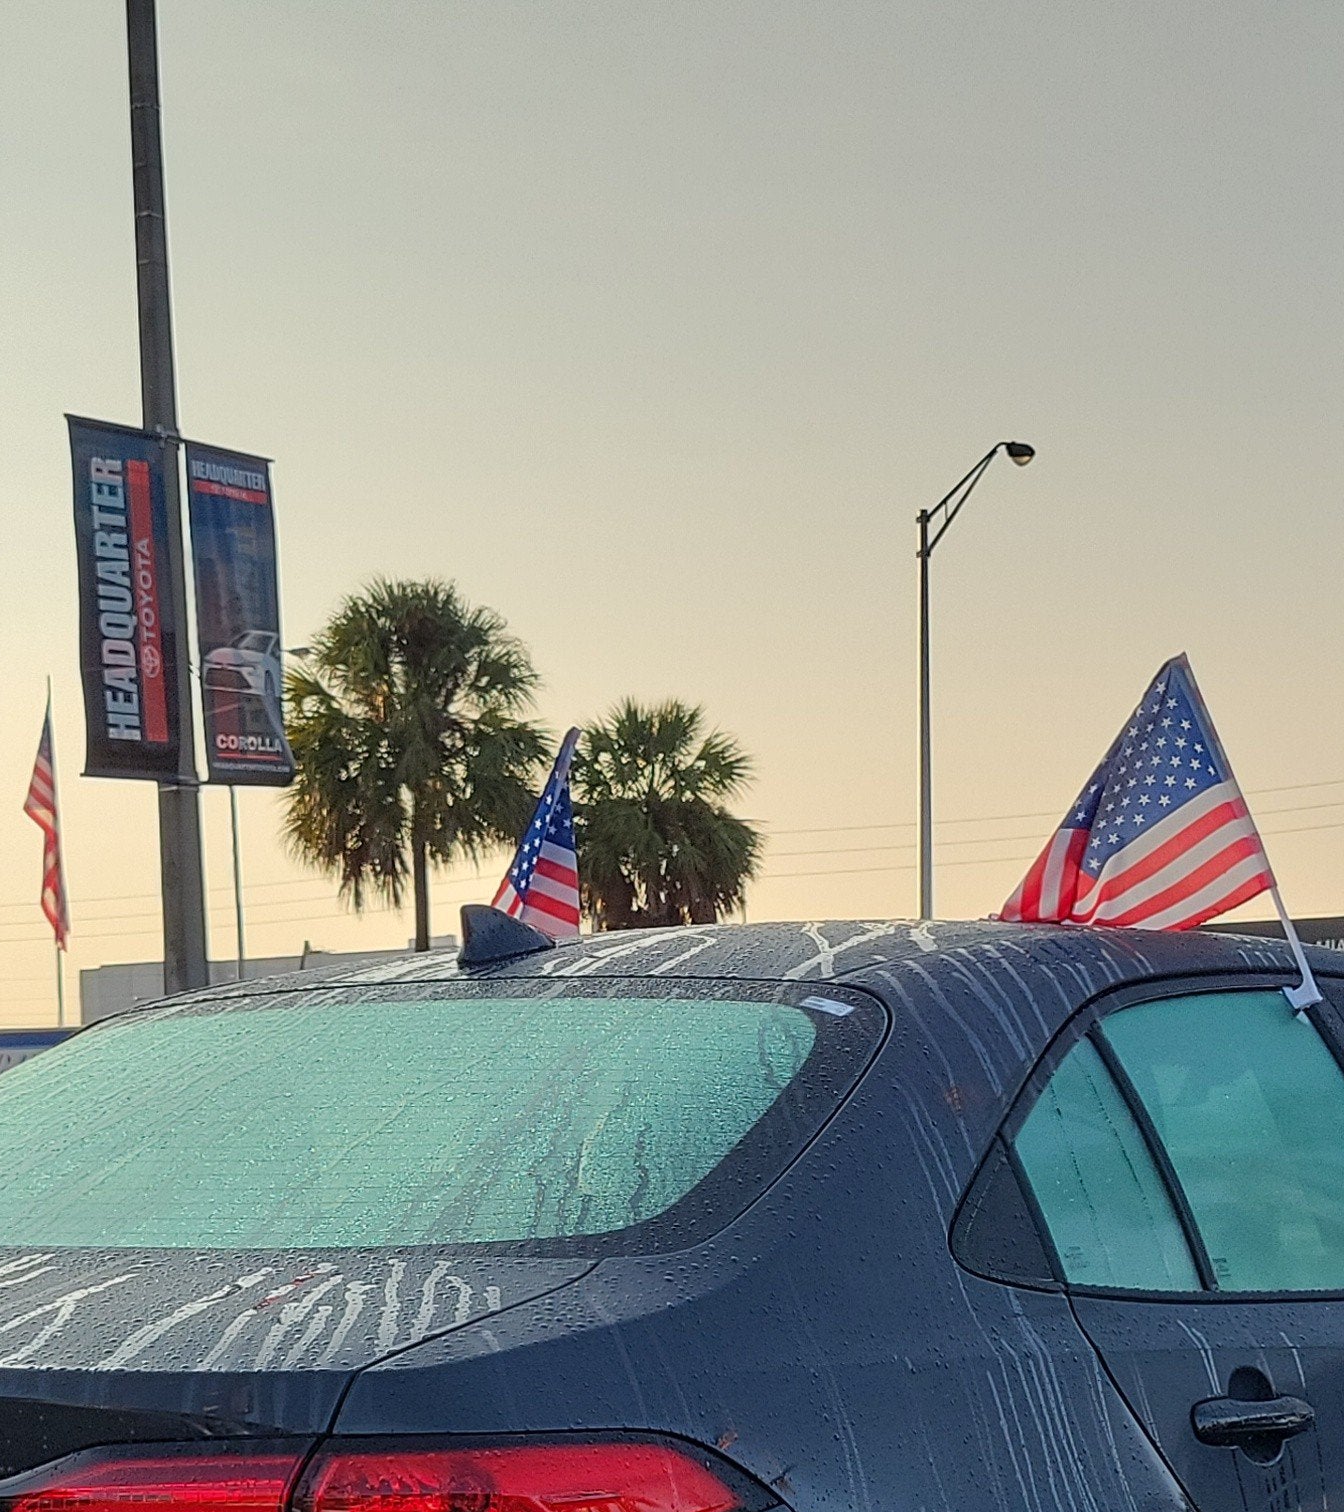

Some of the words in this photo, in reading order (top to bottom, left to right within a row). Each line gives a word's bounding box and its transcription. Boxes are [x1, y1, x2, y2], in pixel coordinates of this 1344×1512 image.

[91, 456, 141, 741] HEADQUARTER
[134, 538, 157, 640] TOYOTA
[216, 734, 283, 752] COROLLA
